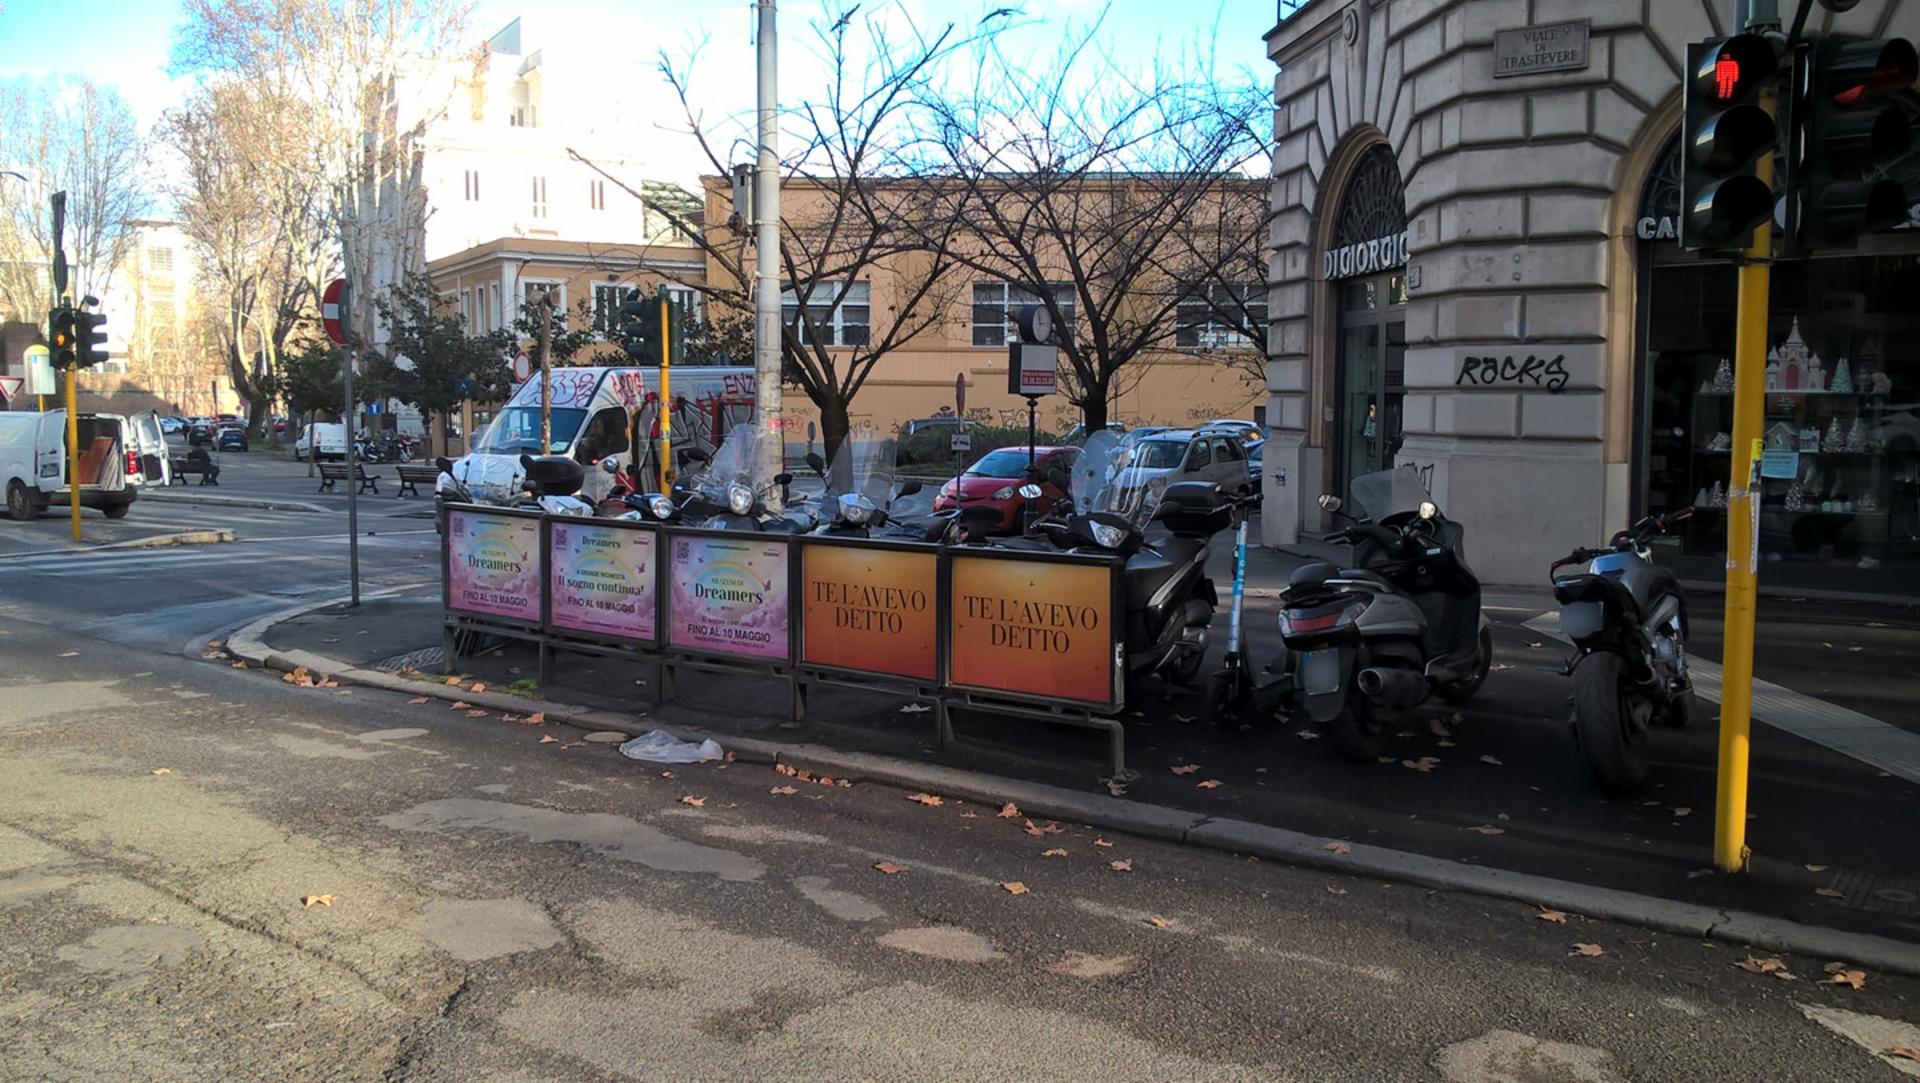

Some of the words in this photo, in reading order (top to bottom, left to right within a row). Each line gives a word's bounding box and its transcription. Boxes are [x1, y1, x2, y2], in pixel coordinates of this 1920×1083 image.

[1523, 29, 1556, 43] VIALE
[1535, 43, 1547, 53] DI
[1504, 49, 1578, 69] TRASTEVERE
[1637, 216, 1682, 240] CA
[582, 536, 622, 550] Dreamers
[468, 554, 522, 573] Dreamers
[558, 575, 565, 586] Il
[567, 578, 595, 591] sogno
[596, 582, 645, 596] continua!
[695, 583, 764, 604] Dreamers
[462, 590, 479, 601] FINO
[480, 592, 489, 602] AL
[490, 593, 498, 603] 10
[499, 594, 528, 608] MAGGIO
[567, 596, 584, 607] FINO
[585, 598, 594, 608] AL
[596, 600, 604, 610] 10
[605, 601, 636, 614] MAGGIO
[812, 581, 838, 603] TE
[840, 583, 927, 613] L'AVEVO
[835, 606, 903, 634] DETTO
[963, 595, 993, 621] TE
[998, 598, 1099, 631] L'AVEVO
[687, 623, 708, 635] FINO
[709, 626, 721, 637] AL
[723, 628, 733, 639] 10
[735, 629, 771, 644] MAGGIO
[990, 623, 1070, 654] DETTO
